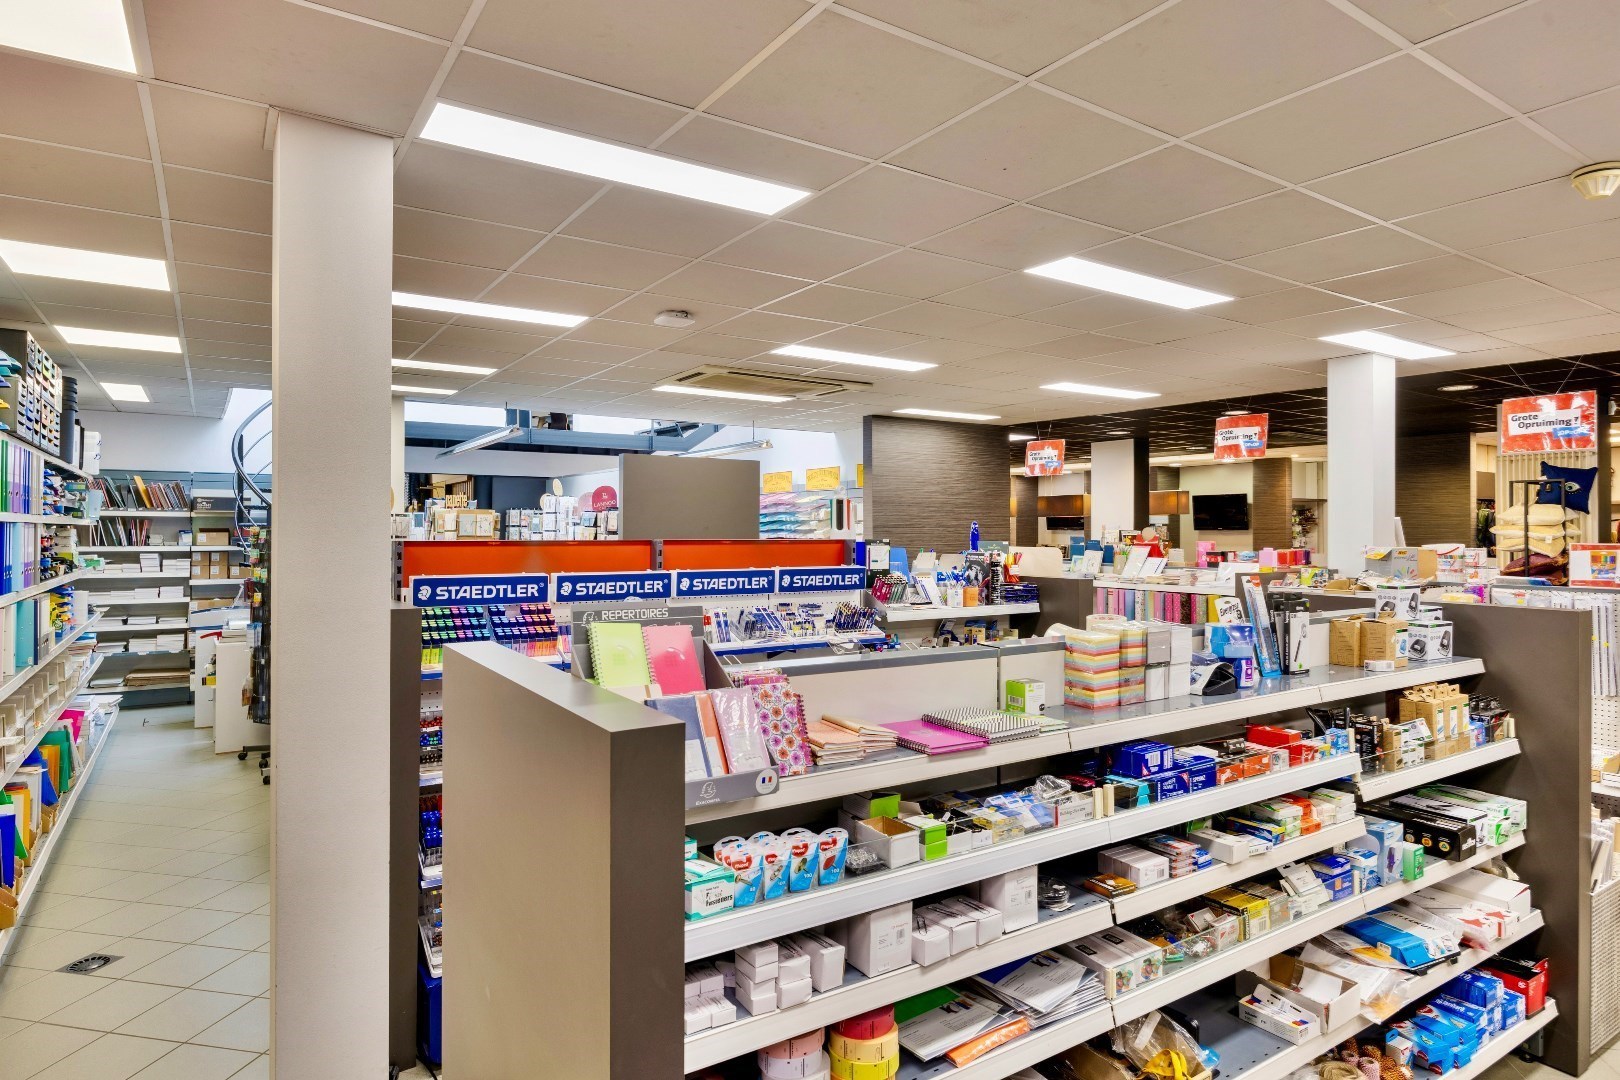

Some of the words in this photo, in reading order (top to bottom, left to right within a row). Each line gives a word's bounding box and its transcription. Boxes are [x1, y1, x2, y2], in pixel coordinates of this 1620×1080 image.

[1510, 413, 1538, 422] Grote
[692, 577, 768, 591] STAEDTLER
[792, 574, 860, 587] STAEDTLER
[435, 584, 539, 600] STAEDTLER
[575, 580, 664, 596] STAEDTLER
[601, 607, 669, 620] REPERTOIRES
